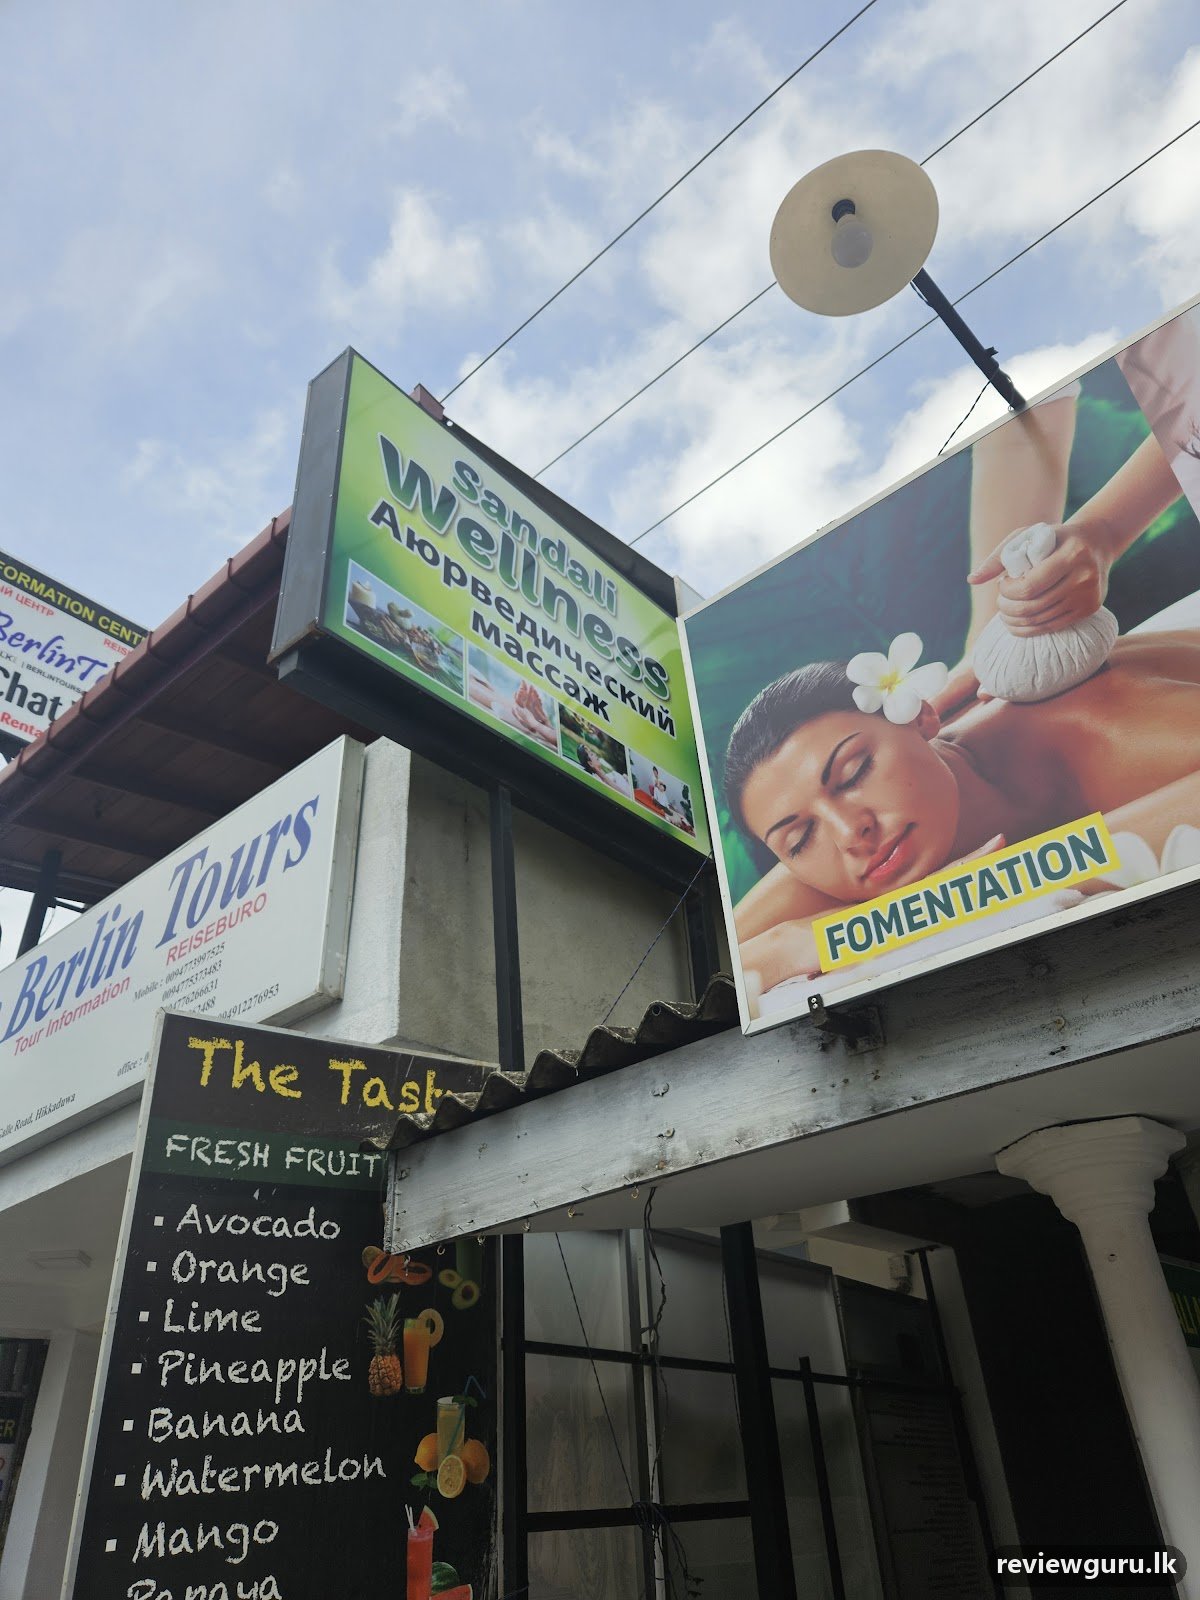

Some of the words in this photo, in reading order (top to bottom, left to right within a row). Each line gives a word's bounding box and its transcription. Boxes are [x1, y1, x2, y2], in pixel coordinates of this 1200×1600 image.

[452, 459, 618, 615] Sandali
[377, 432, 672, 702] Wellness
[15, 592, 54, 617] ЦЕНТР
[98, 616, 146, 645] CENT
[369, 499, 677, 740] Аюрведический
[0, 611, 108, 684] BerlinT
[103, 637, 130, 656] REIS
[471, 610, 611, 723] массаж
[0, 903, 144, 1043] Berlin
[155, 795, 319, 949] Tours
[826, 827, 1108, 961] FOMENTATION
[166, 892, 267, 966] REISEBURO
[13, 1028, 44, 1056] Tour
[46, 976, 131, 1037] Information
[188, 1036, 301, 1099] The
[165, 1134, 270, 1170] FRESH
[285, 1145, 382, 1178] FRUIT
[176, 1203, 341, 1240] Avocado
[171, 1249, 310, 1297] Orange
[162, 1298, 262, 1333] Lime
[158, 1346, 352, 1404] Pineapple
[147, 1407, 306, 1443] Banana
[140, 1446, 386, 1501] Watermelon
[132, 1519, 279, 1564] Mango
